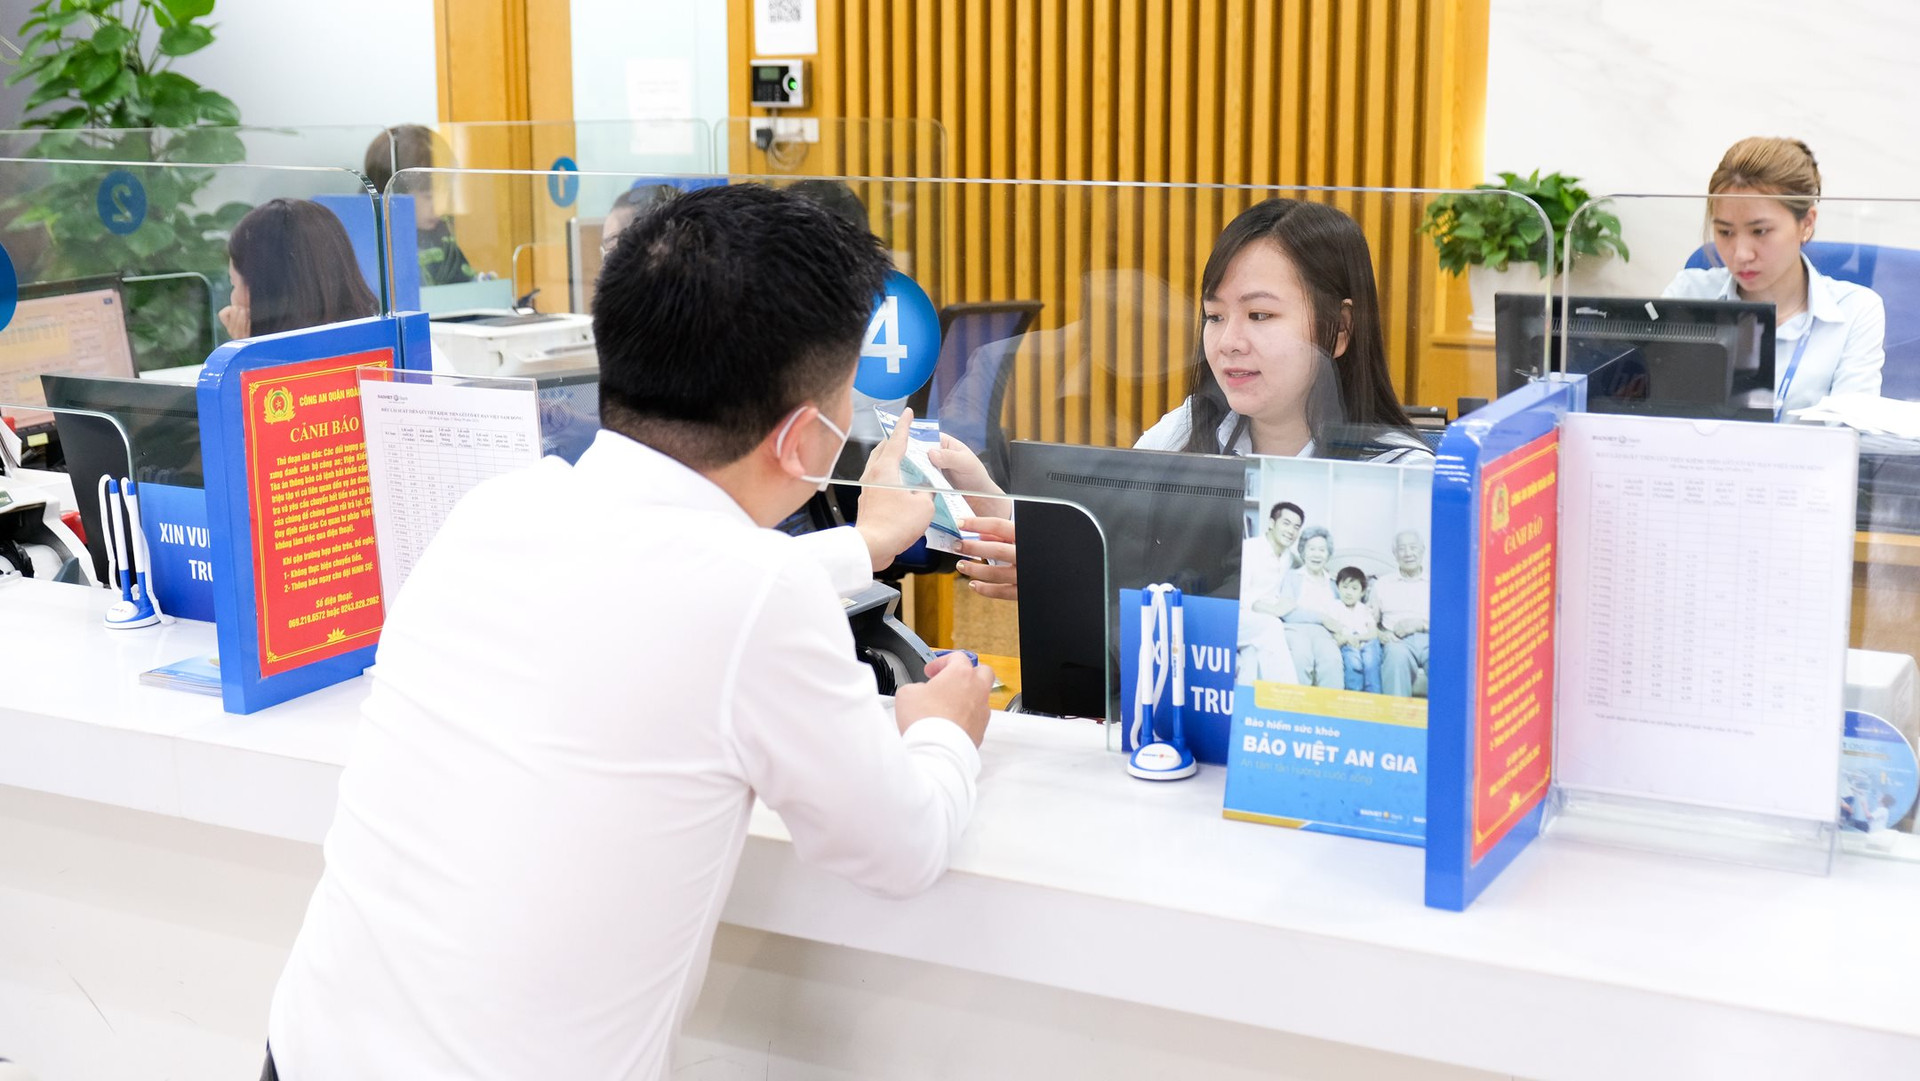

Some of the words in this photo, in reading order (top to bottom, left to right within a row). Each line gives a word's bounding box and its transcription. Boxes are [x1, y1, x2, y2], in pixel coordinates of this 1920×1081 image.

[860, 296, 907, 373] 4
[299, 392, 317, 407] CÔNG
[318, 392, 327, 403] AN
[328, 388, 345, 403] QUẬN
[290, 420, 328, 442] CẢNH
[332, 415, 359, 434] BÁO
[159, 522, 184, 545] XIN
[186, 526, 210, 548] VUI
[1191, 644, 1230, 673] VUI
[1244, 716, 1264, 728] Bảo
[1266, 718, 1291, 732] hiểm
[1294, 722, 1313, 734] sức
[1243, 732, 1286, 756] BẢO
[1292, 740, 1339, 766] VIỆT
[1344, 749, 1374, 768] AN
[1381, 753, 1418, 774] GIA
